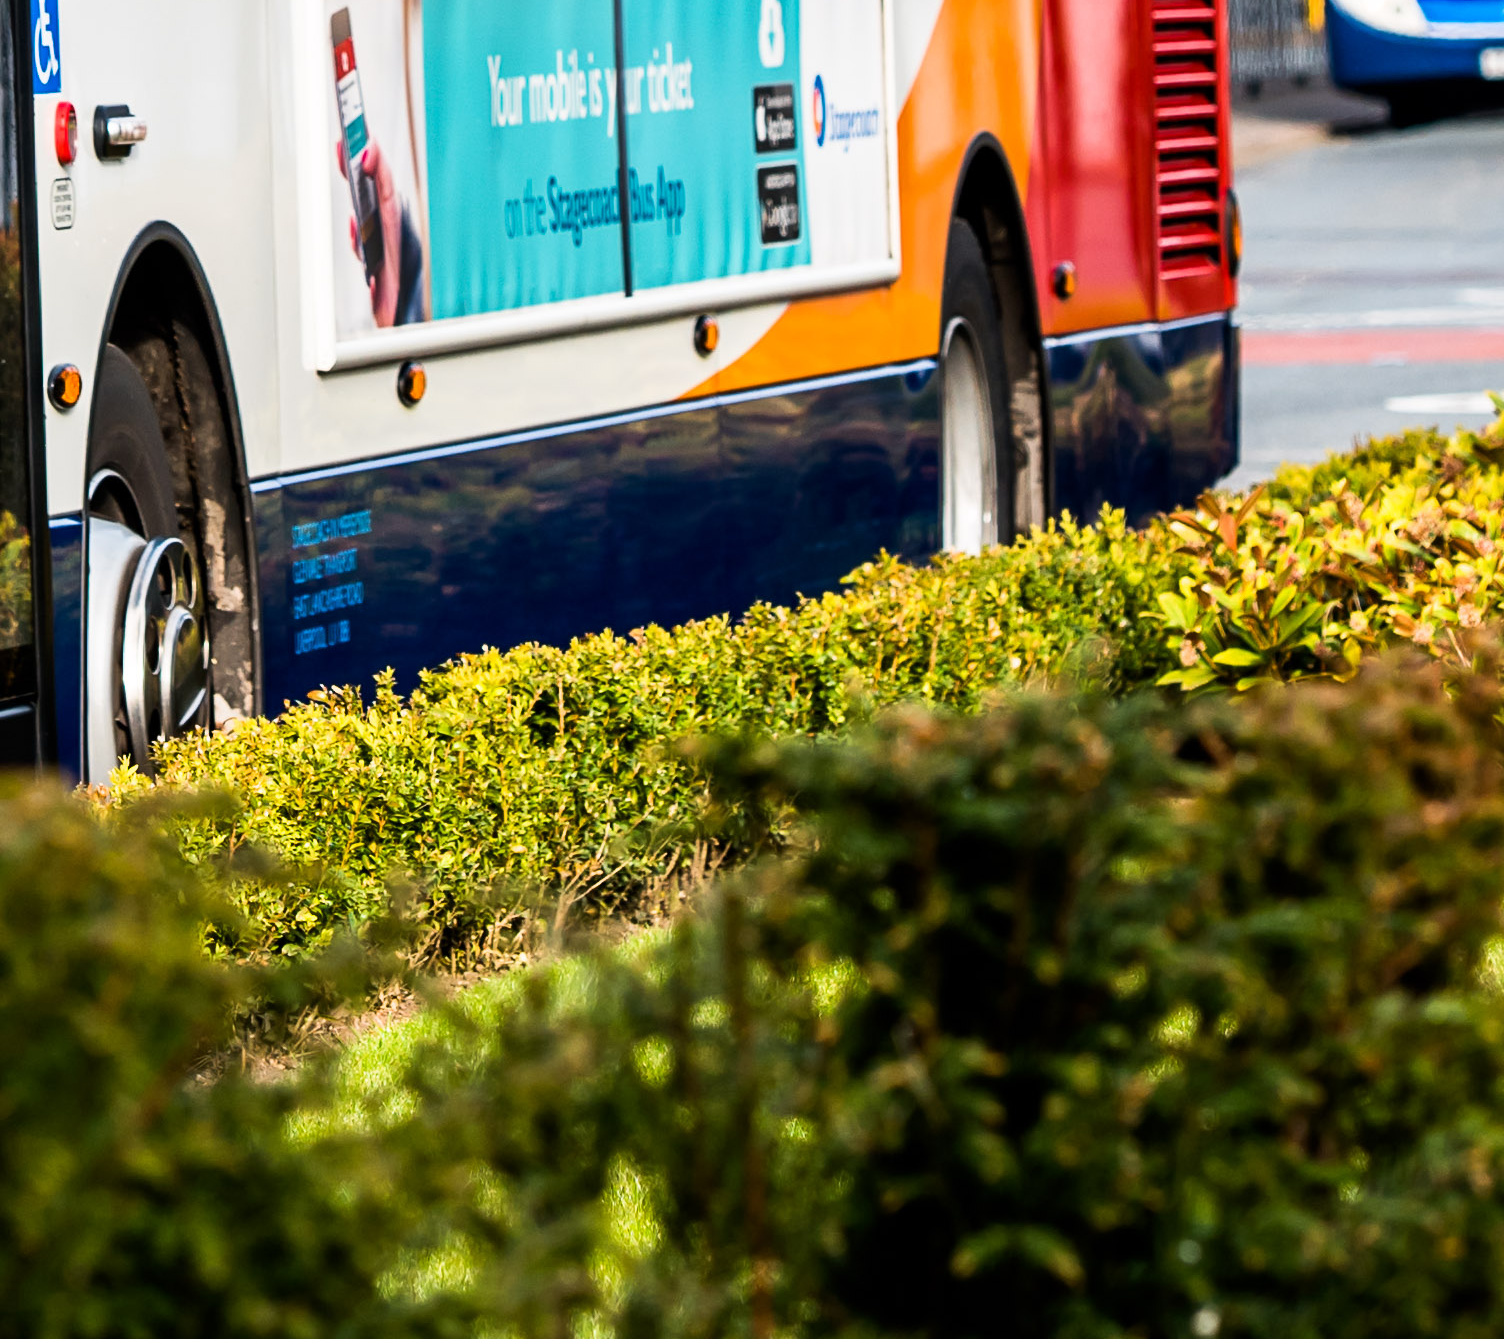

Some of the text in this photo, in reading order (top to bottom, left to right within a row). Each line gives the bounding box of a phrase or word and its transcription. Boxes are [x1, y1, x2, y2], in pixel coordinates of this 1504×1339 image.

[487, 54, 526, 127] Your
[528, 48, 588, 124] mobile
[588, 51, 603, 117] is
[604, 65, 645, 138] yur
[504, 197, 523, 240] on
[523, 178, 548, 237] the
[656, 165, 686, 237] App
